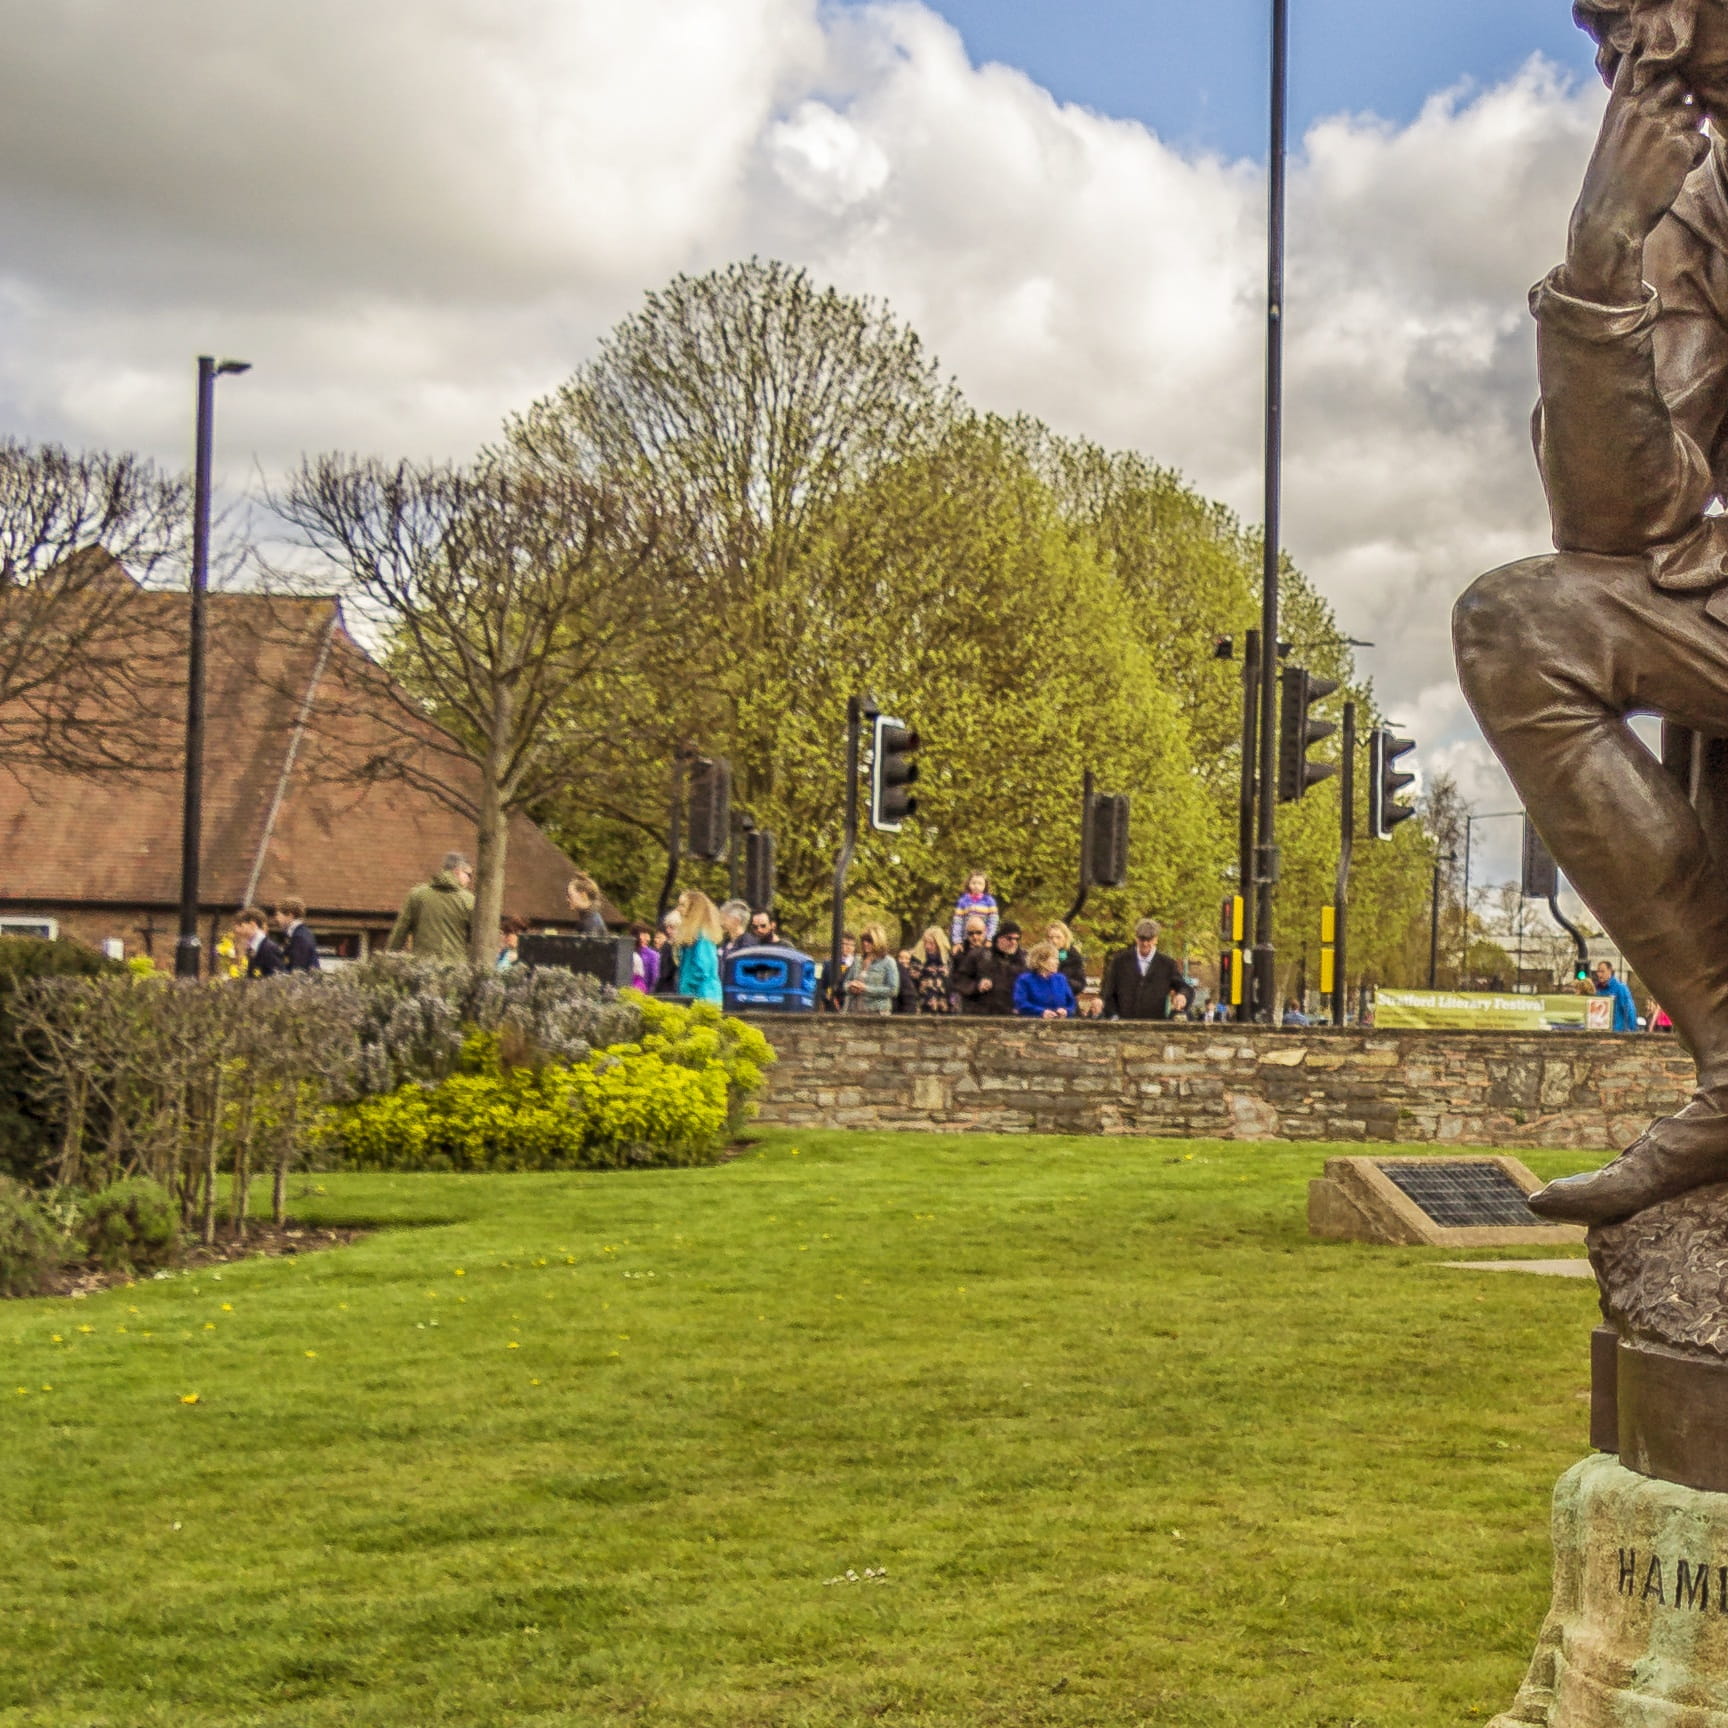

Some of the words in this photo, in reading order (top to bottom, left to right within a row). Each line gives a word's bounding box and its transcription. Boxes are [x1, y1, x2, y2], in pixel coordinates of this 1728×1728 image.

[1377, 992, 1436, 1008] Stratford
[1438, 996, 1492, 1012] Literary
[1494, 997, 1545, 1012] Festival
